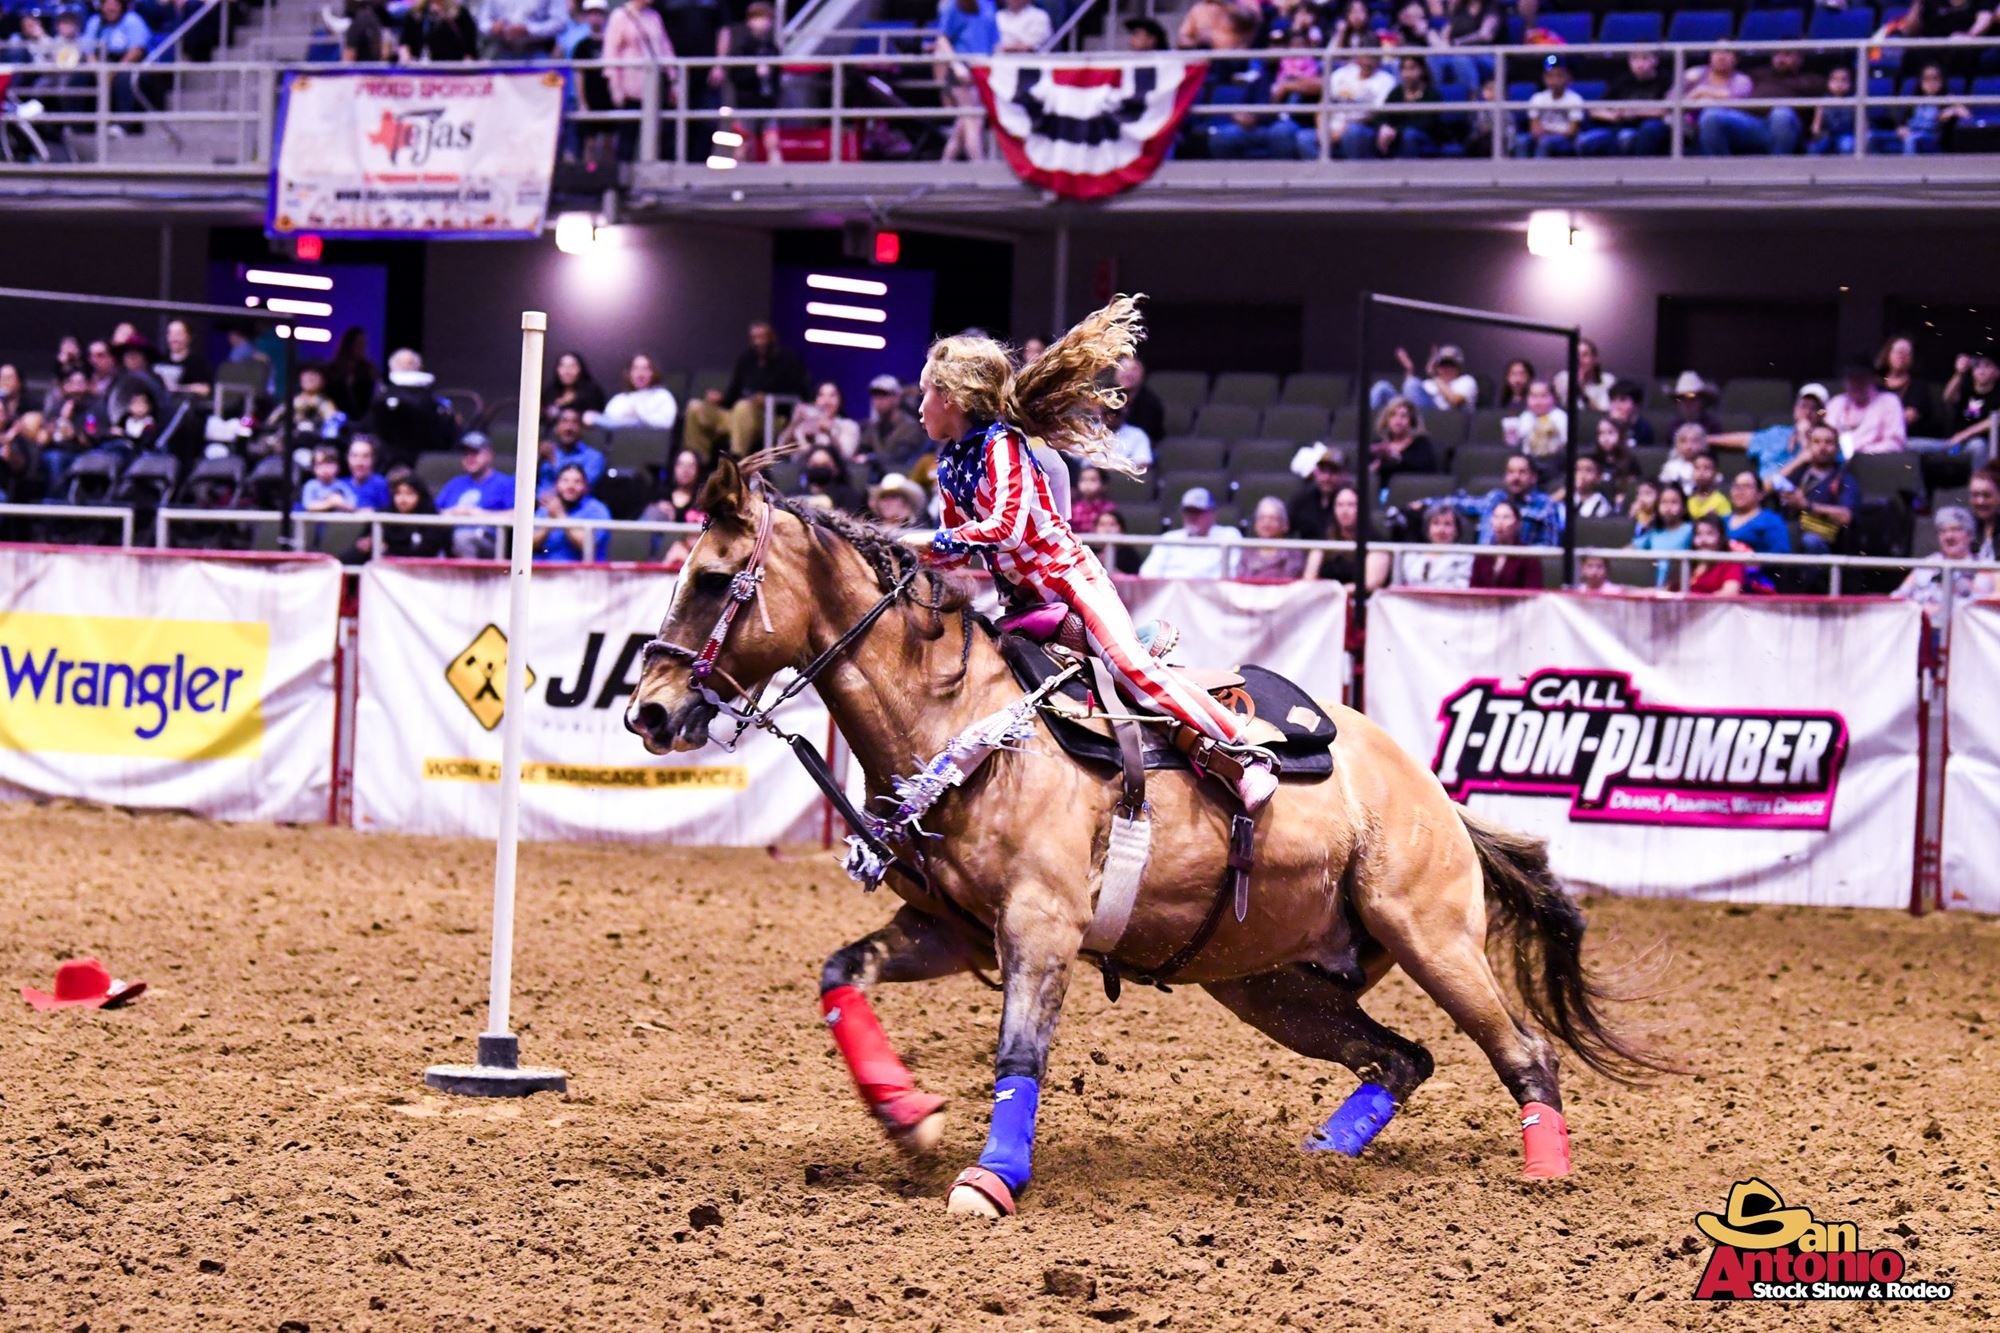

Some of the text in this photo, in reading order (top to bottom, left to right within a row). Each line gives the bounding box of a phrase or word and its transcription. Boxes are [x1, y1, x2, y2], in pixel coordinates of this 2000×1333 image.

[1, 645, 243, 739] Wrangler
[1531, 678, 1627, 707] CALL
[427, 762, 480, 777] WORK
[547, 767, 647, 786] BARRICADE
[655, 768, 745, 785] SERVICES
[1437, 687, 1834, 801] 1-TOM-PLUMBER
